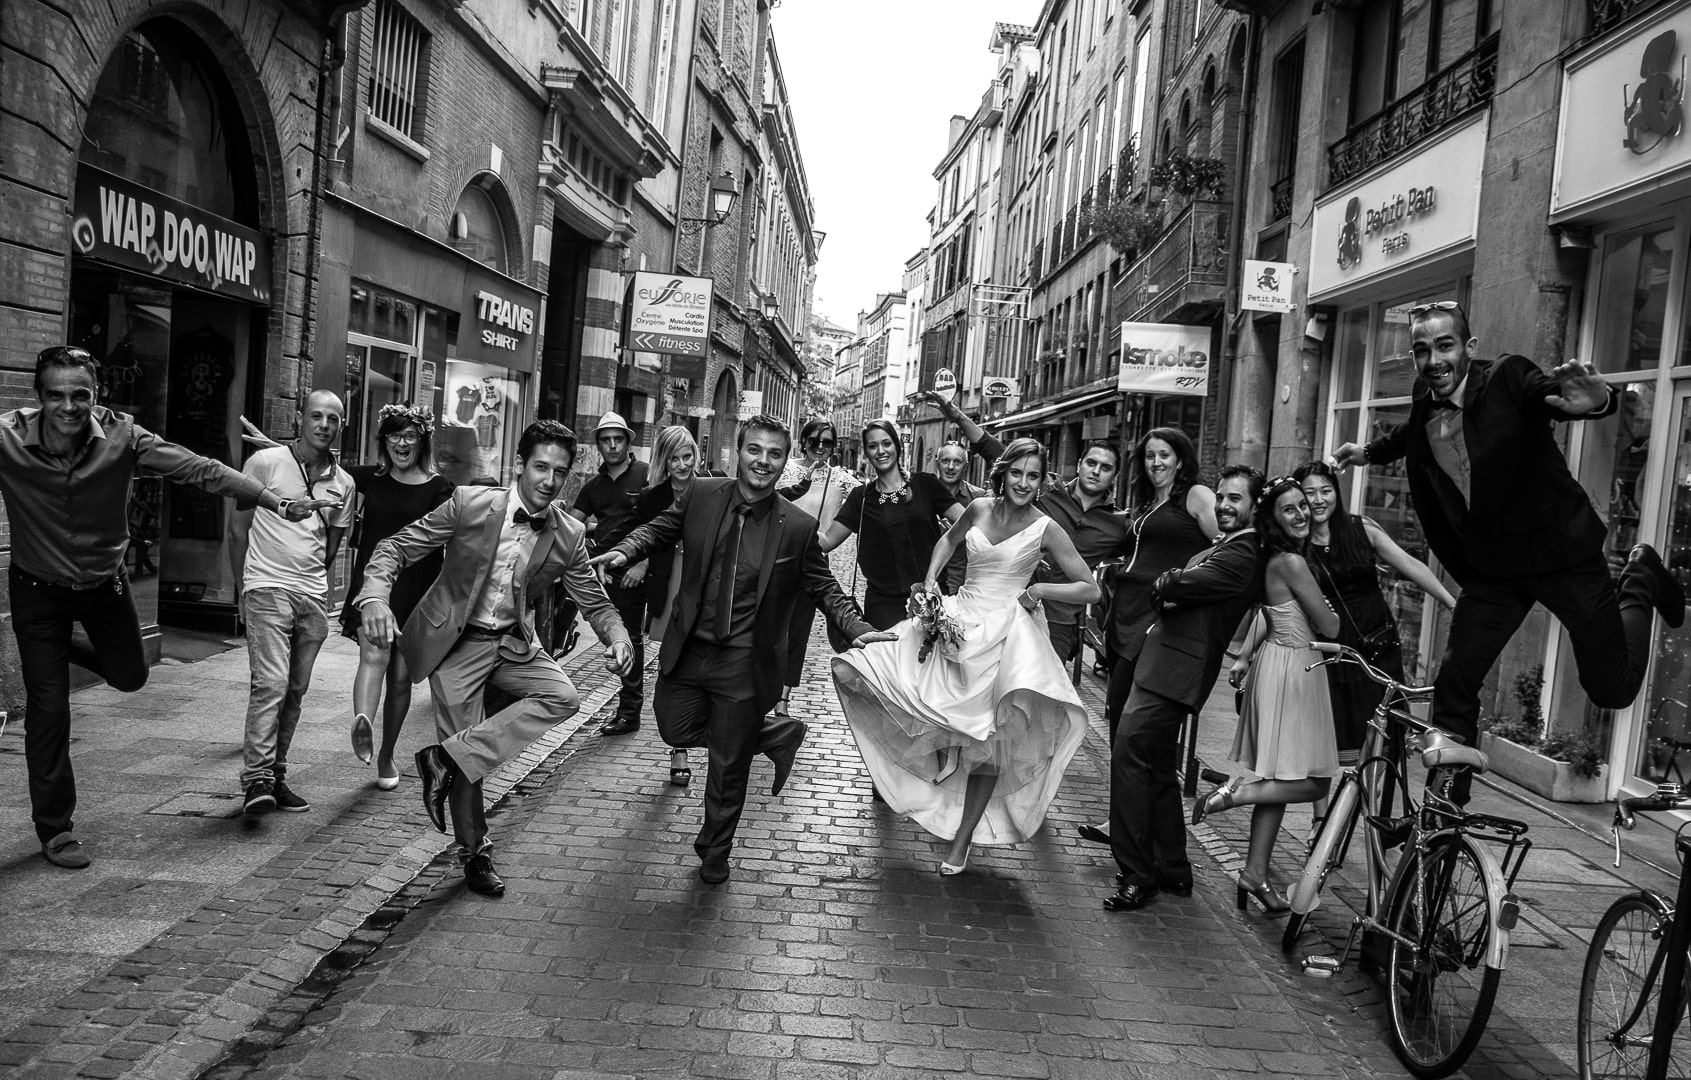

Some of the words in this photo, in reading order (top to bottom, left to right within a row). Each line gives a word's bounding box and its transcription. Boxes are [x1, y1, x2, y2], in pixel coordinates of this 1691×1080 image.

[1365, 193, 1404, 236] Petit
[1407, 185, 1434, 217] Pan
[99, 185, 156, 256] WAP
[163, 210, 209, 274] DOO
[1382, 232, 1409, 254] Paris
[1247, 294, 1269, 303] Petit
[1271, 296, 1286, 304] Pan
[478, 289, 534, 335] TRANS
[641, 311, 662, 319] Centre
[684, 312, 705, 320] Cardio
[669, 318, 705, 326] Musculation
[692, 326, 704, 334] Spa
[481, 329, 519, 351] SHIRT
[658, 335, 701, 352] fitness
